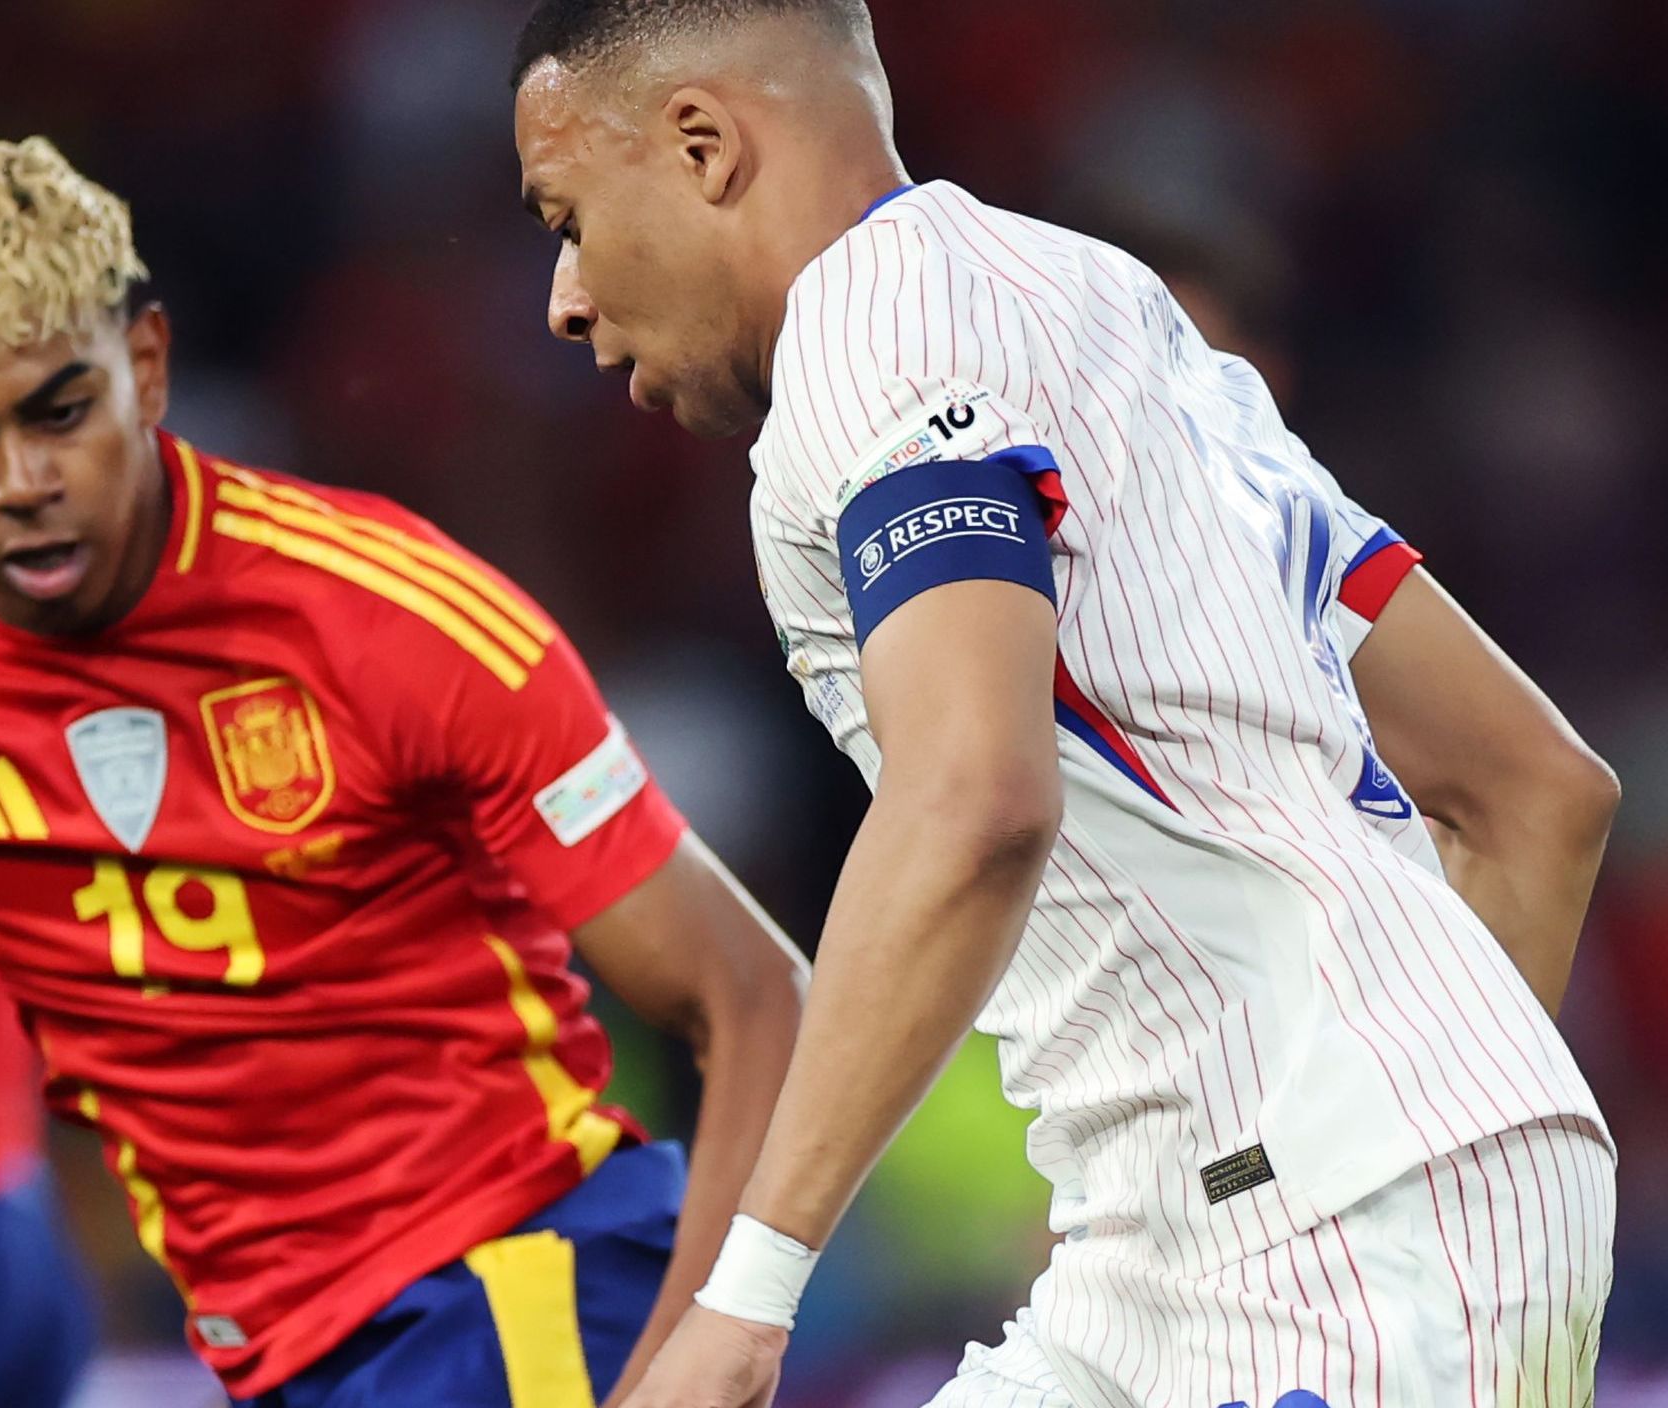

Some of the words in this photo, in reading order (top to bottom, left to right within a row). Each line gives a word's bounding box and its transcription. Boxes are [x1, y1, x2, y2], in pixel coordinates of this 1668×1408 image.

[928, 401, 975, 441] 10
[888, 505, 1020, 553] RESPECT
[72, 856, 266, 986] 19
